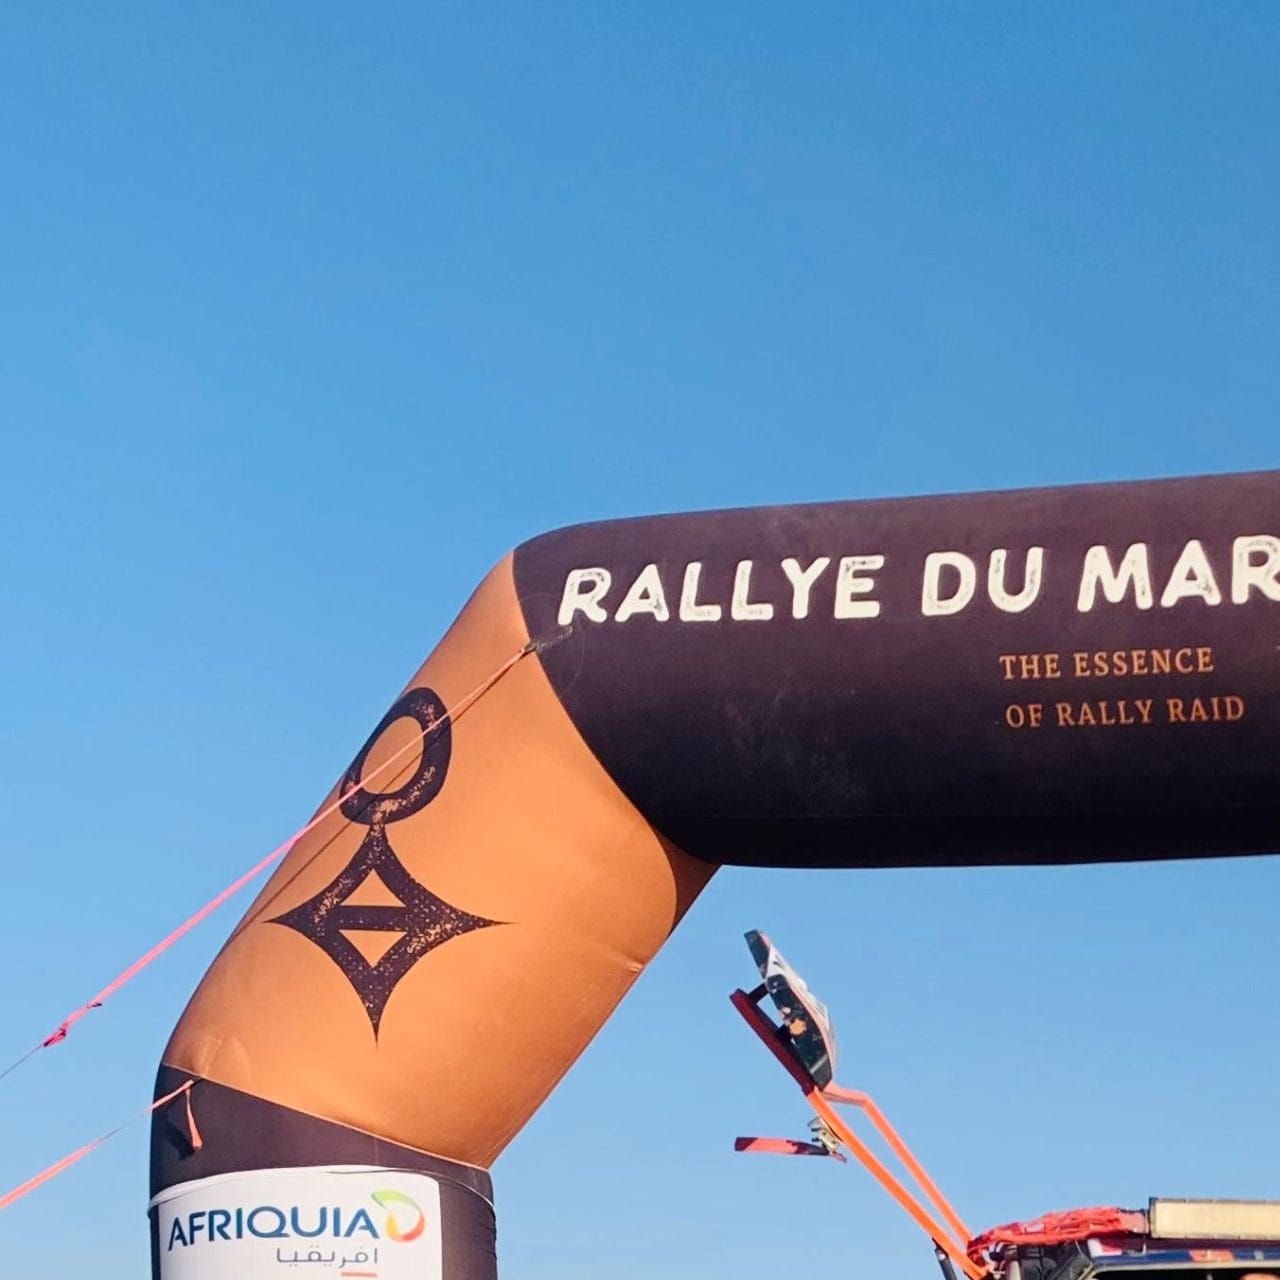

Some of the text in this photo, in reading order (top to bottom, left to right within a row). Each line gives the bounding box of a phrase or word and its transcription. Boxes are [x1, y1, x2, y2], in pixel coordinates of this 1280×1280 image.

[557, 554, 885, 627] RALLYE
[920, 547, 1044, 617] DU
[998, 645, 1214, 680] THE ESSENCE
[1005, 694, 1245, 729] OF RALLY RAID
[167, 1205, 380, 1252] AFRIQUIA
